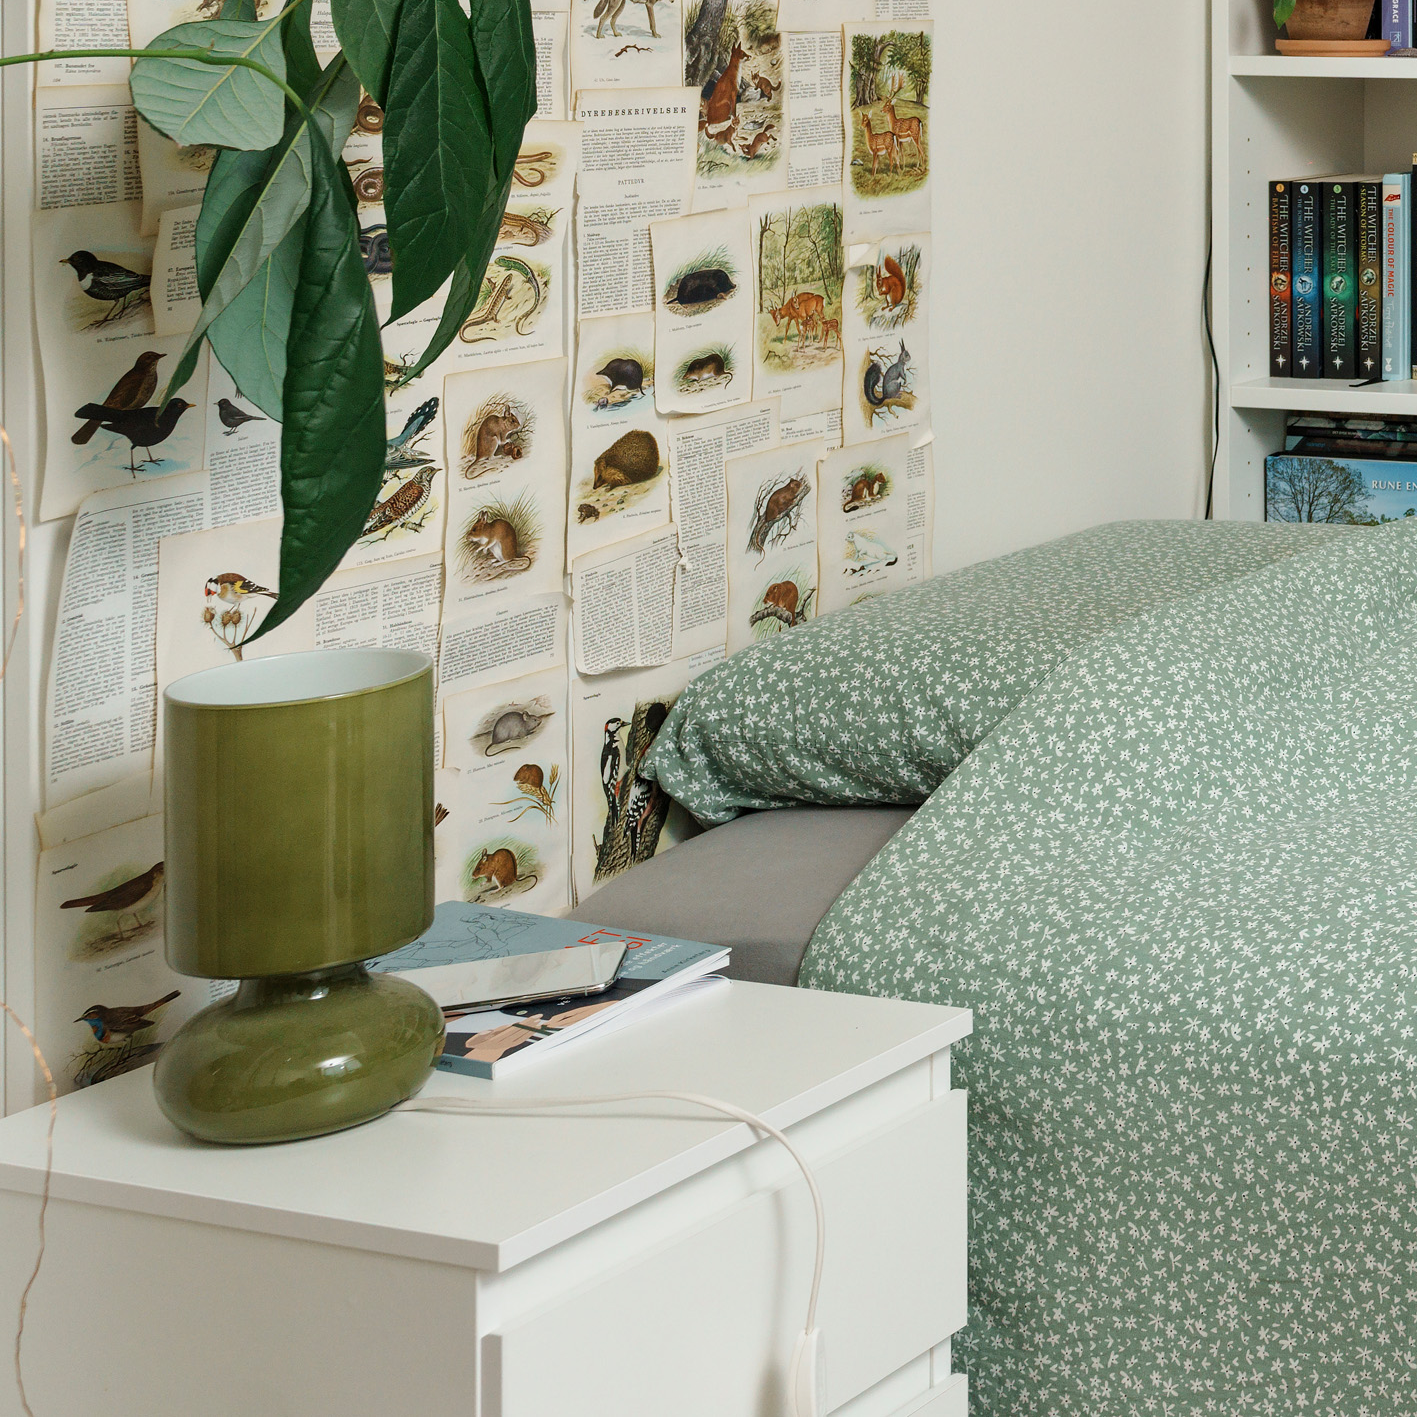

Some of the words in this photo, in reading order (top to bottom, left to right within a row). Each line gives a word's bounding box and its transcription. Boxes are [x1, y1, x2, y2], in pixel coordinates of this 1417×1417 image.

[580, 107, 687, 118] DYREBESKRIVELSER
[1387, 222, 1395, 256] COLOUR
[1387, 258, 1395, 269] OF
[1387, 271, 1395, 297] MAGIC
[1371, 479, 1402, 491] RUNE
